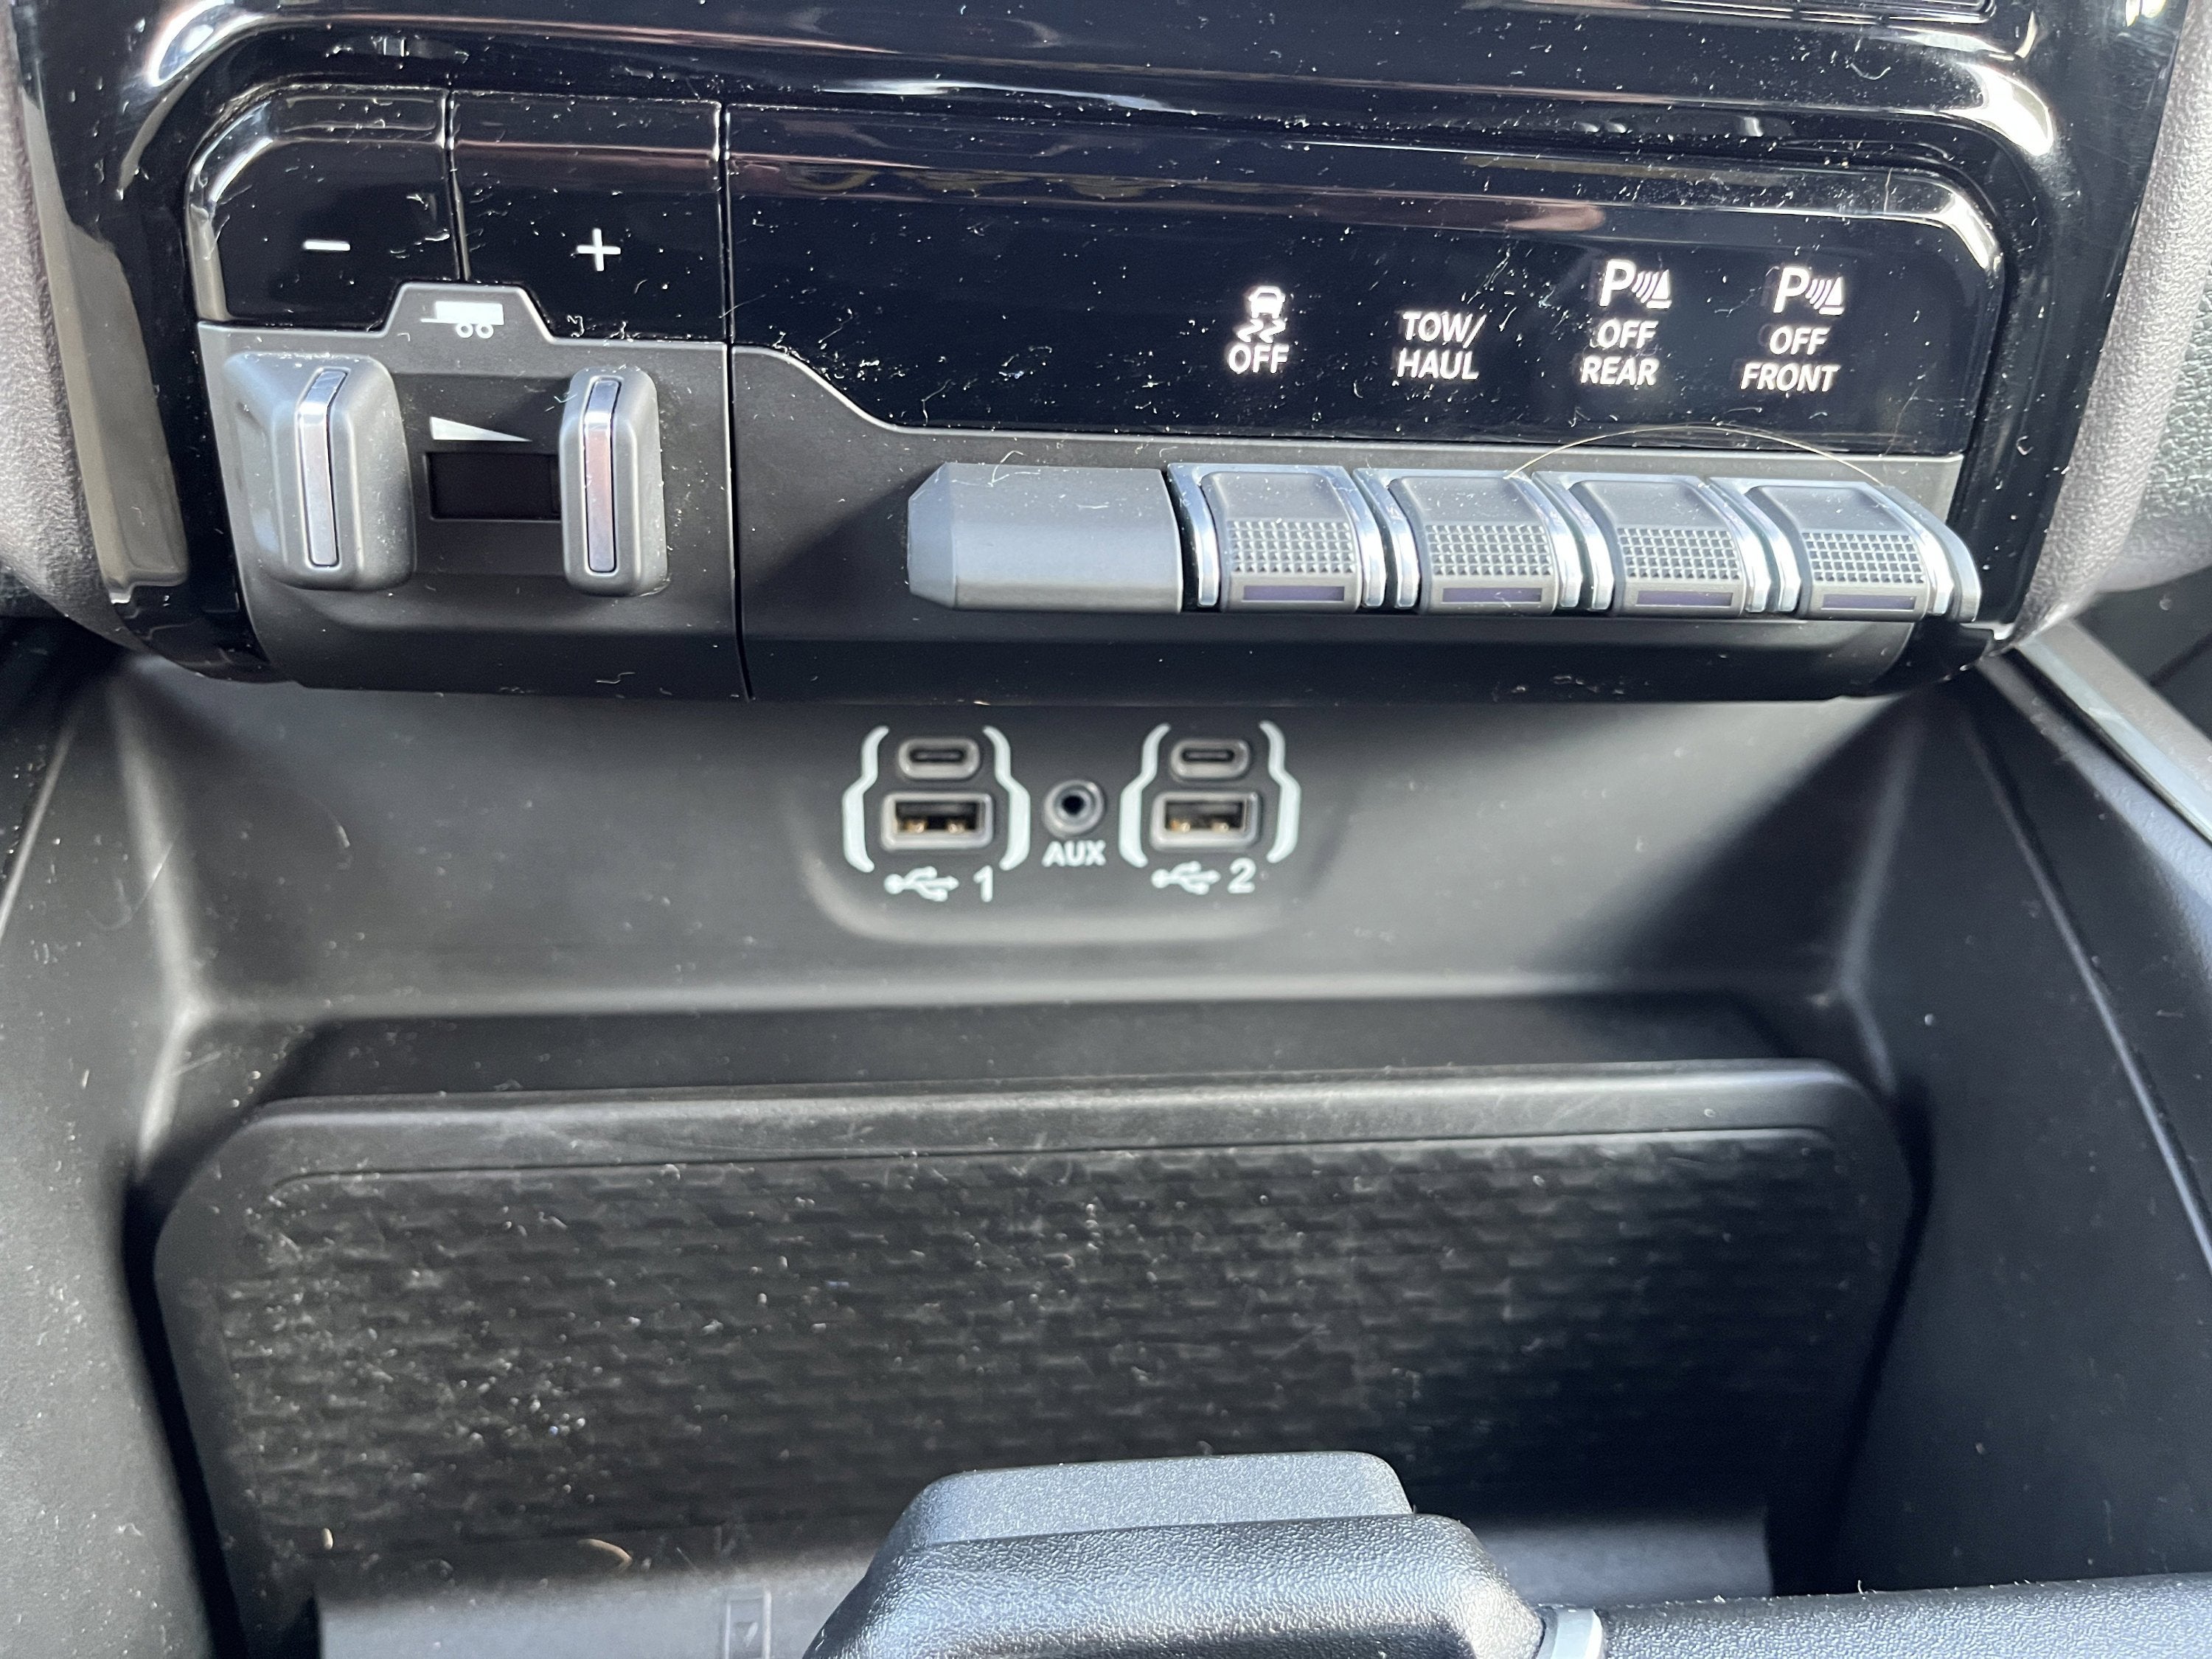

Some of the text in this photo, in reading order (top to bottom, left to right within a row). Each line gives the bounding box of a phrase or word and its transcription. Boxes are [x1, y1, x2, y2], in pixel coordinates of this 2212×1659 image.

[1402, 310, 1485, 349] TOW/
[1597, 318, 1659, 349] OFF
[1769, 325, 1830, 355] OFF
[1227, 341, 1290, 375] OFF
[1397, 348, 1479, 380] HAUL
[1580, 355, 1659, 387] REAR
[1740, 361, 1840, 392] FRONT
[1041, 839, 1107, 868] AUX
[973, 865, 994, 903] 1
[1226, 857, 1257, 894] 2
